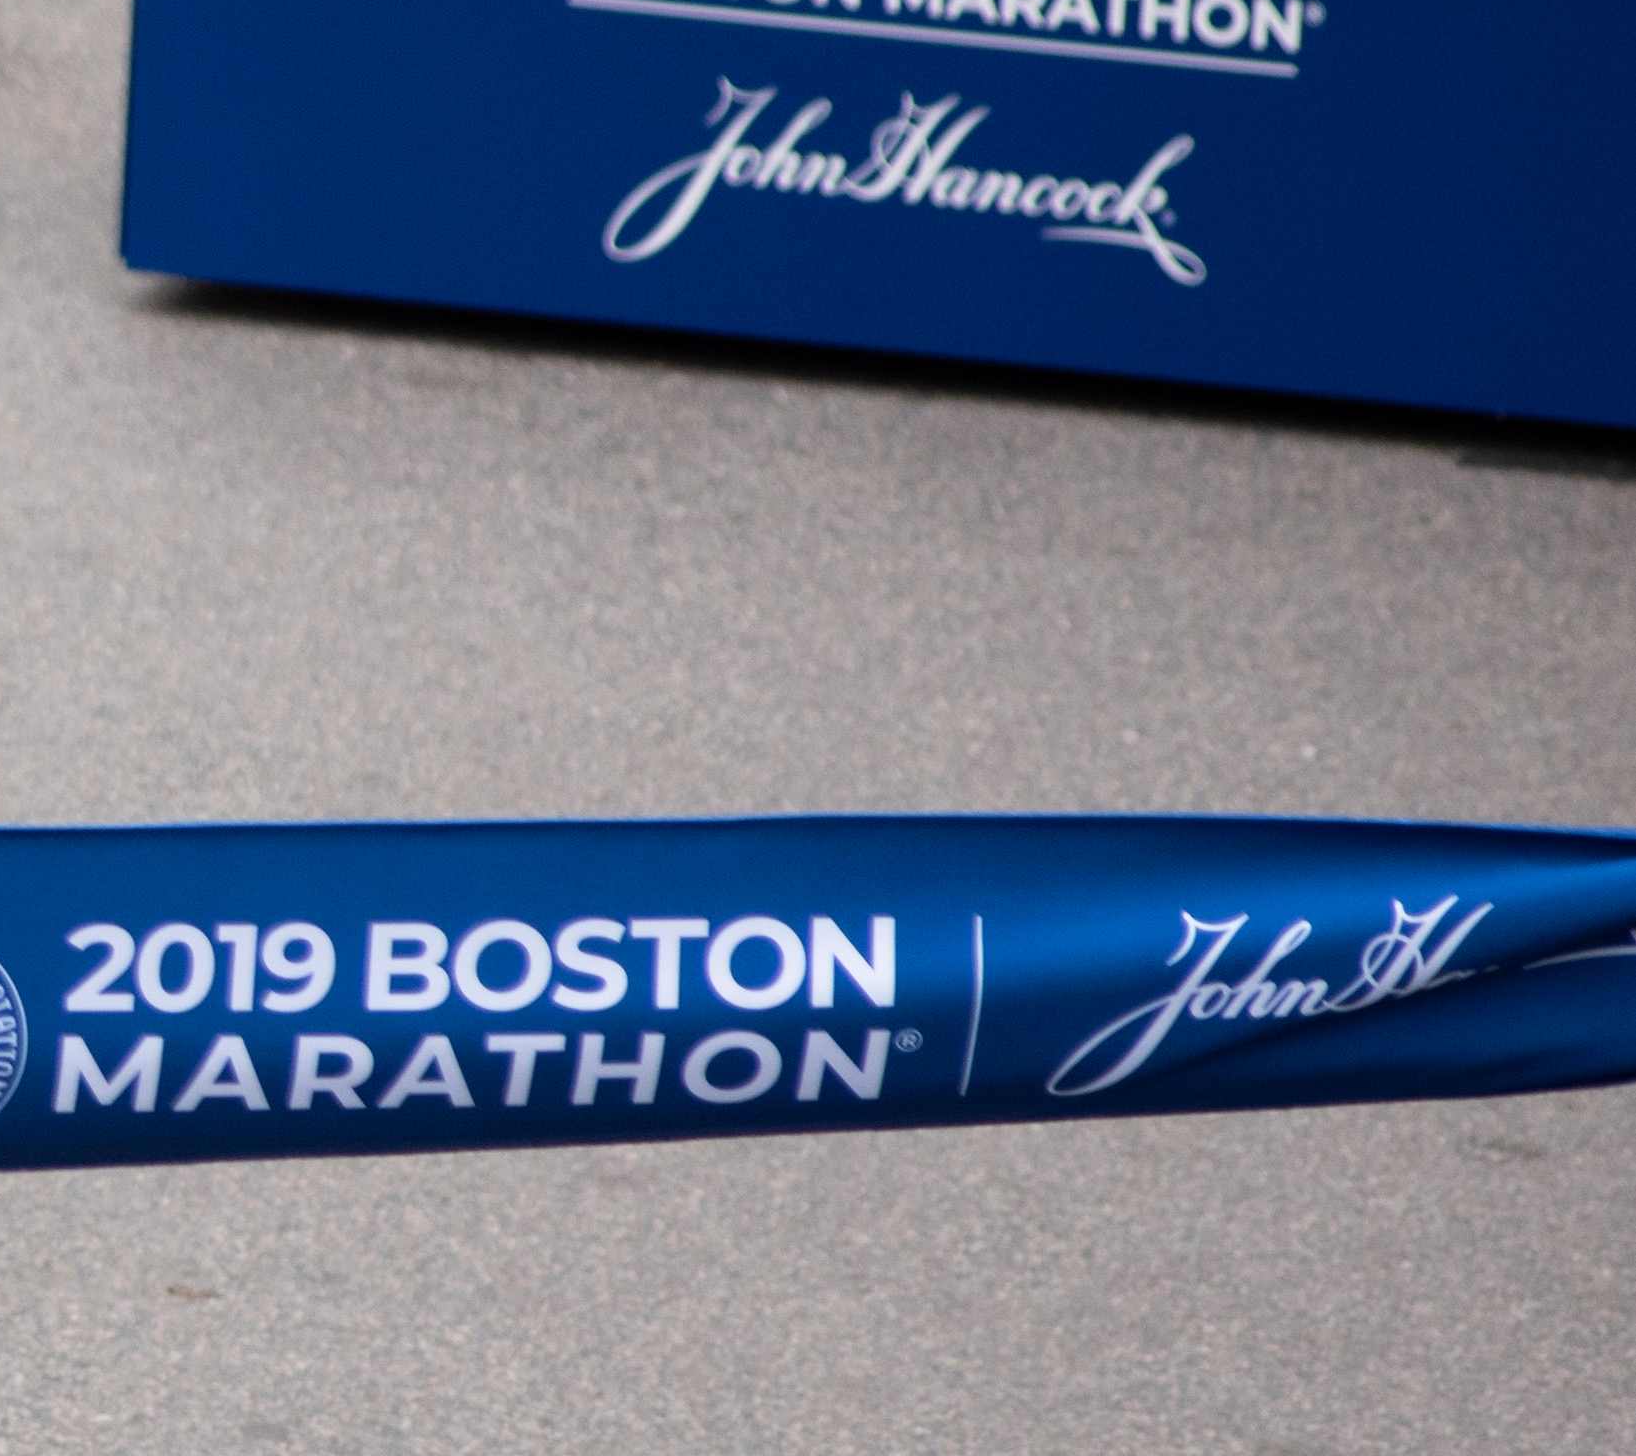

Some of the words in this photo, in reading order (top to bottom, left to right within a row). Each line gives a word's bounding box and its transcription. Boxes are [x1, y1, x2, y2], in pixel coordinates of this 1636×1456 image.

[600, 74, 846, 264] John
[841, 90, 1208, 288] Hancock
[64, 921, 338, 1014] 2019
[364, 914, 898, 1013] BOSTON
[1046, 909, 1329, 1097] John
[52, 1028, 890, 1115] MARATHON
